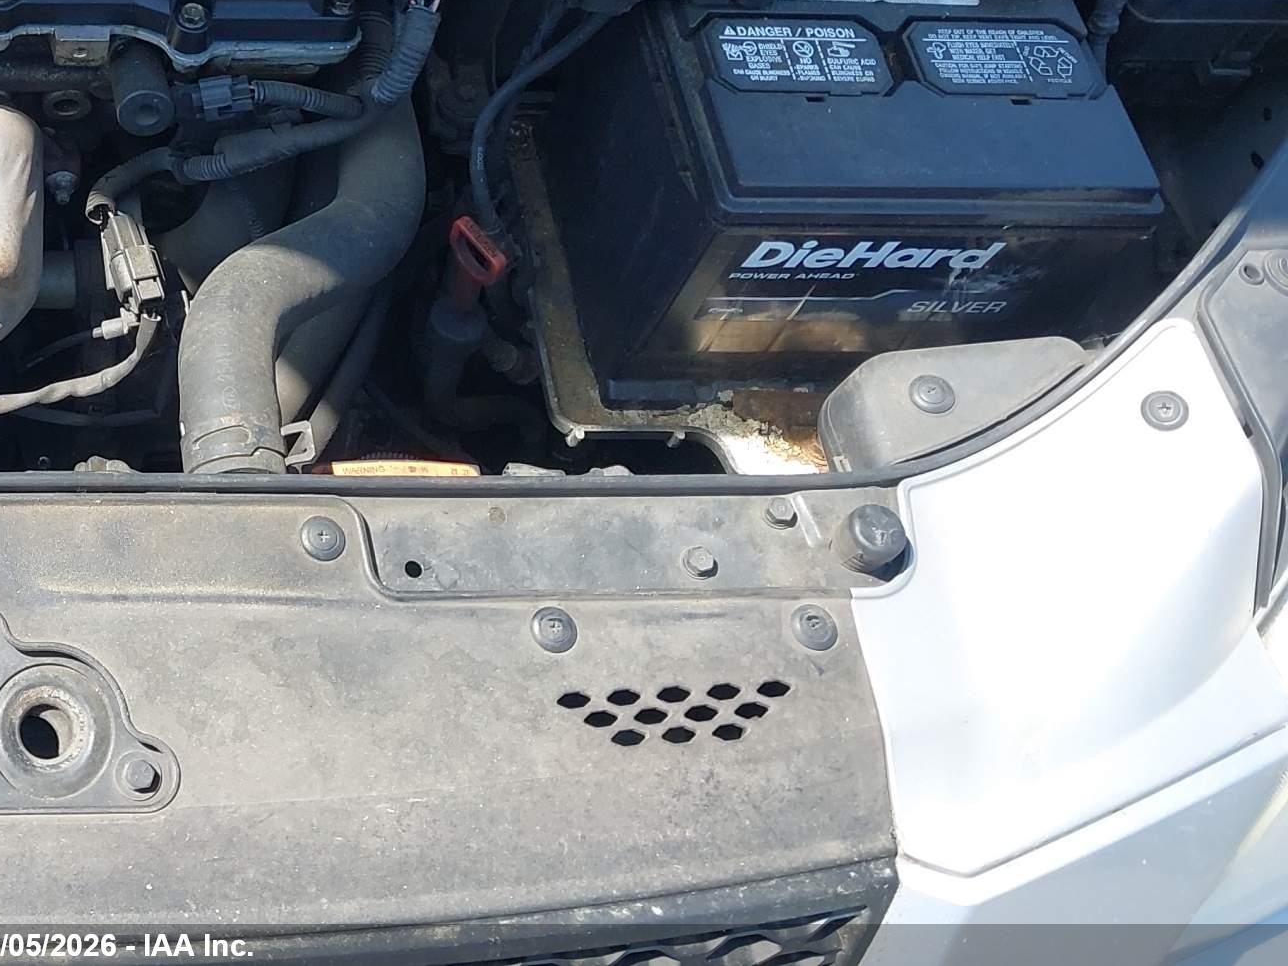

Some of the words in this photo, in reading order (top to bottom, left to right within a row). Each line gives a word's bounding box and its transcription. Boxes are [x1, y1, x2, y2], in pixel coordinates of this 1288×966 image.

[736, 26, 793, 37] DANGER
[805, 27, 855, 38] POISON
[741, 240, 1008, 270] DieHard
[728, 272, 792, 281] POWER
[794, 272, 856, 281] AHEAD
[907, 300, 1009, 314] SILVER
[341, 465, 386, 475] WARNING
